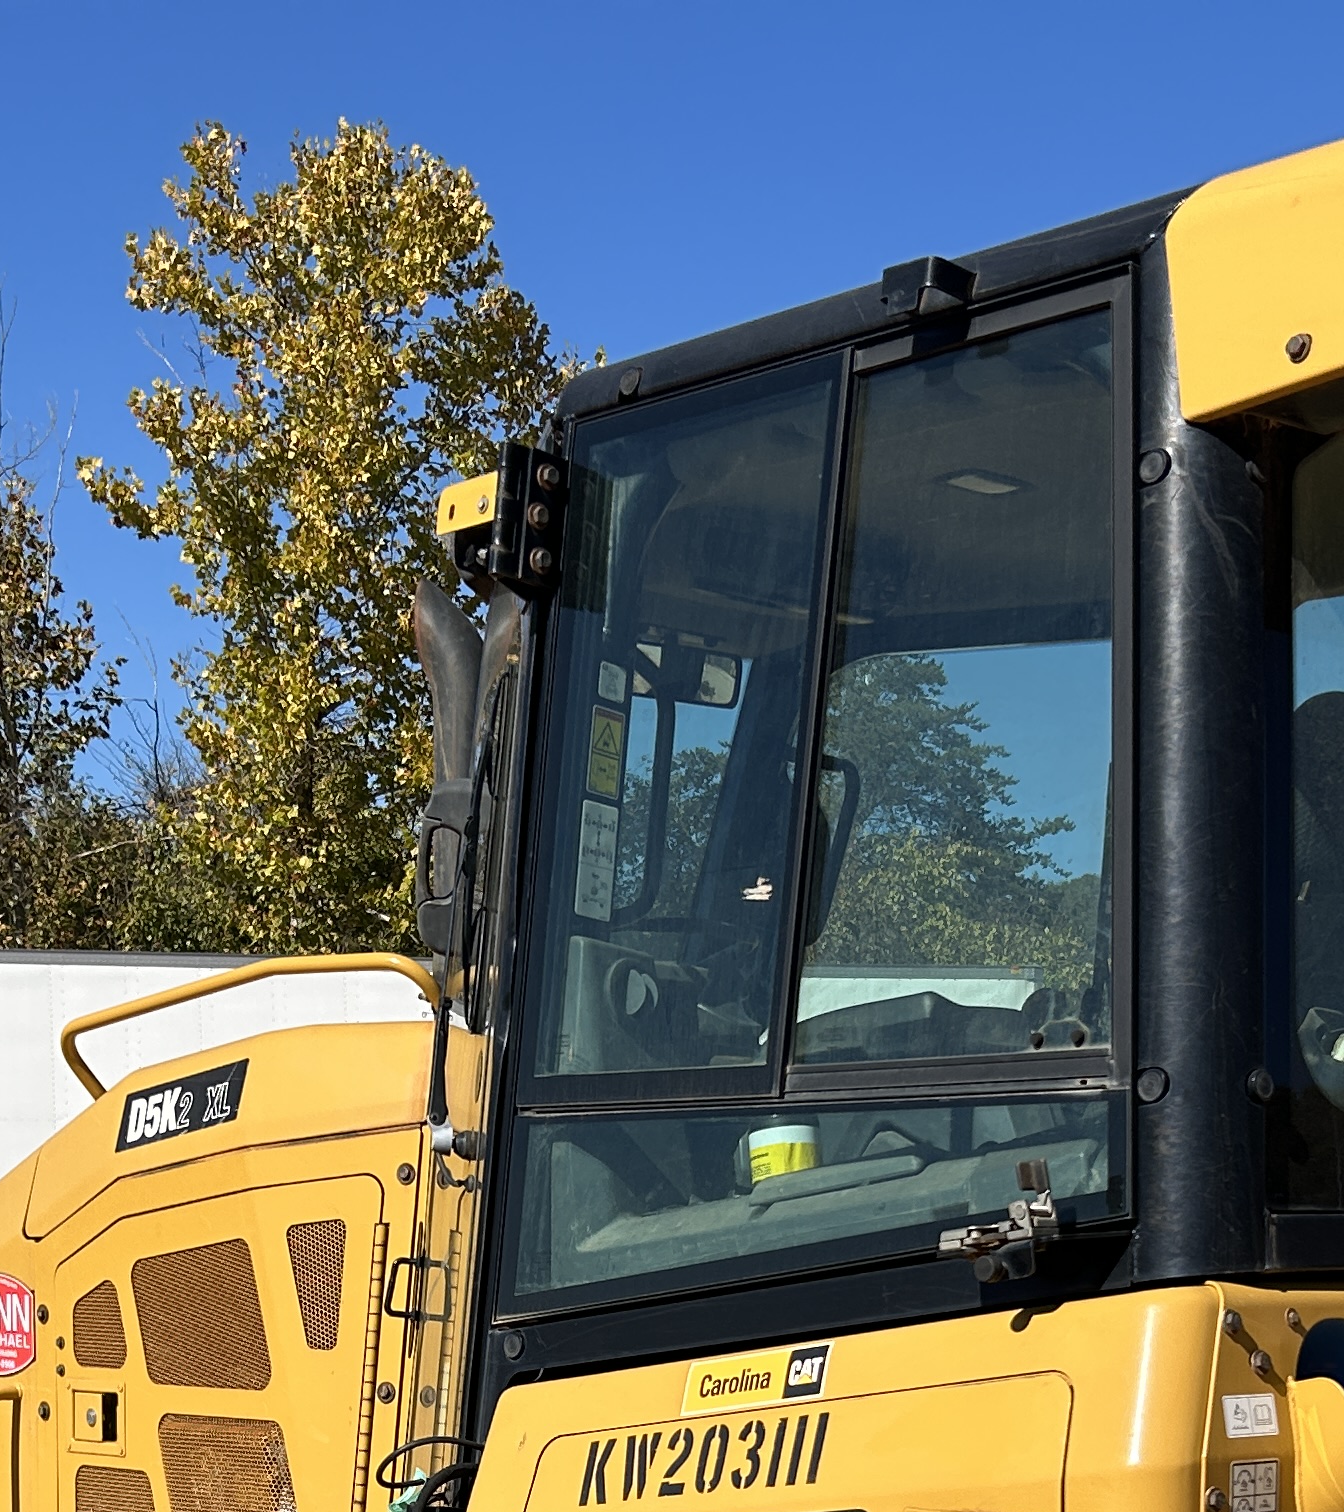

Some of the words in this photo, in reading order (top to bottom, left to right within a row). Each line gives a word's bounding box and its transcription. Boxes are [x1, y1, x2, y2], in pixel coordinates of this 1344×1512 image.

[125, 1086, 194, 1144] D5K2
[202, 1081, 231, 1122] XL
[699, 1368, 772, 1398] Carolina
[787, 1356, 825, 1387] CAT
